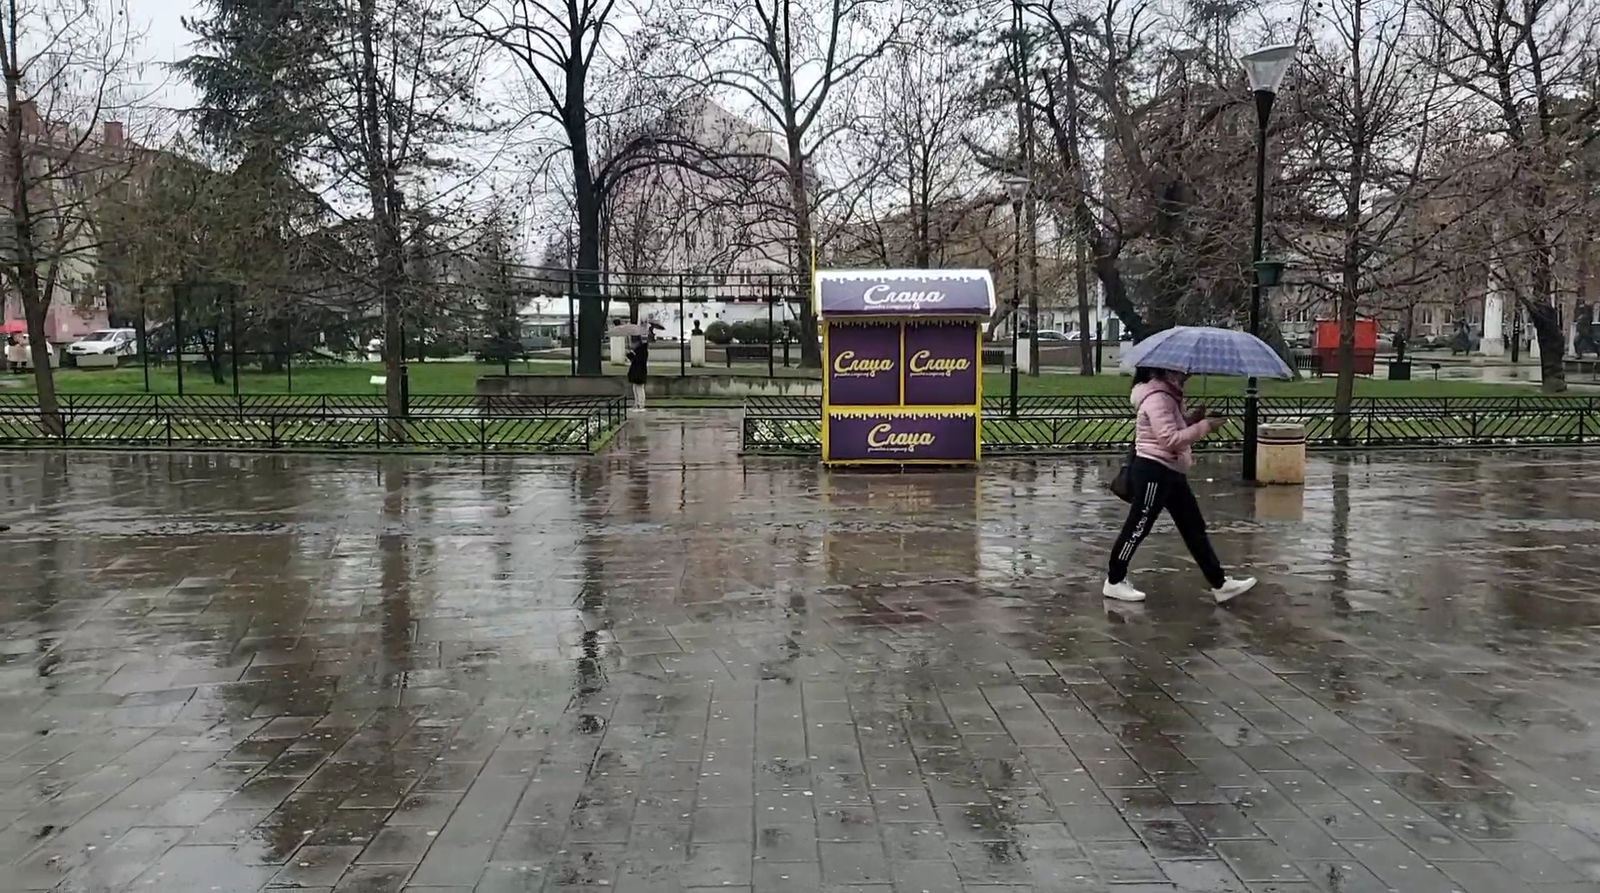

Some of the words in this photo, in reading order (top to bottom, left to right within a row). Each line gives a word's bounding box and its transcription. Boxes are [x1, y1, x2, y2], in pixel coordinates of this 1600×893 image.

[863, 284, 946, 309] Слаца
[834, 350, 895, 377] Слаца
[909, 349, 971, 377] Слаца
[867, 423, 936, 452] Слаца
